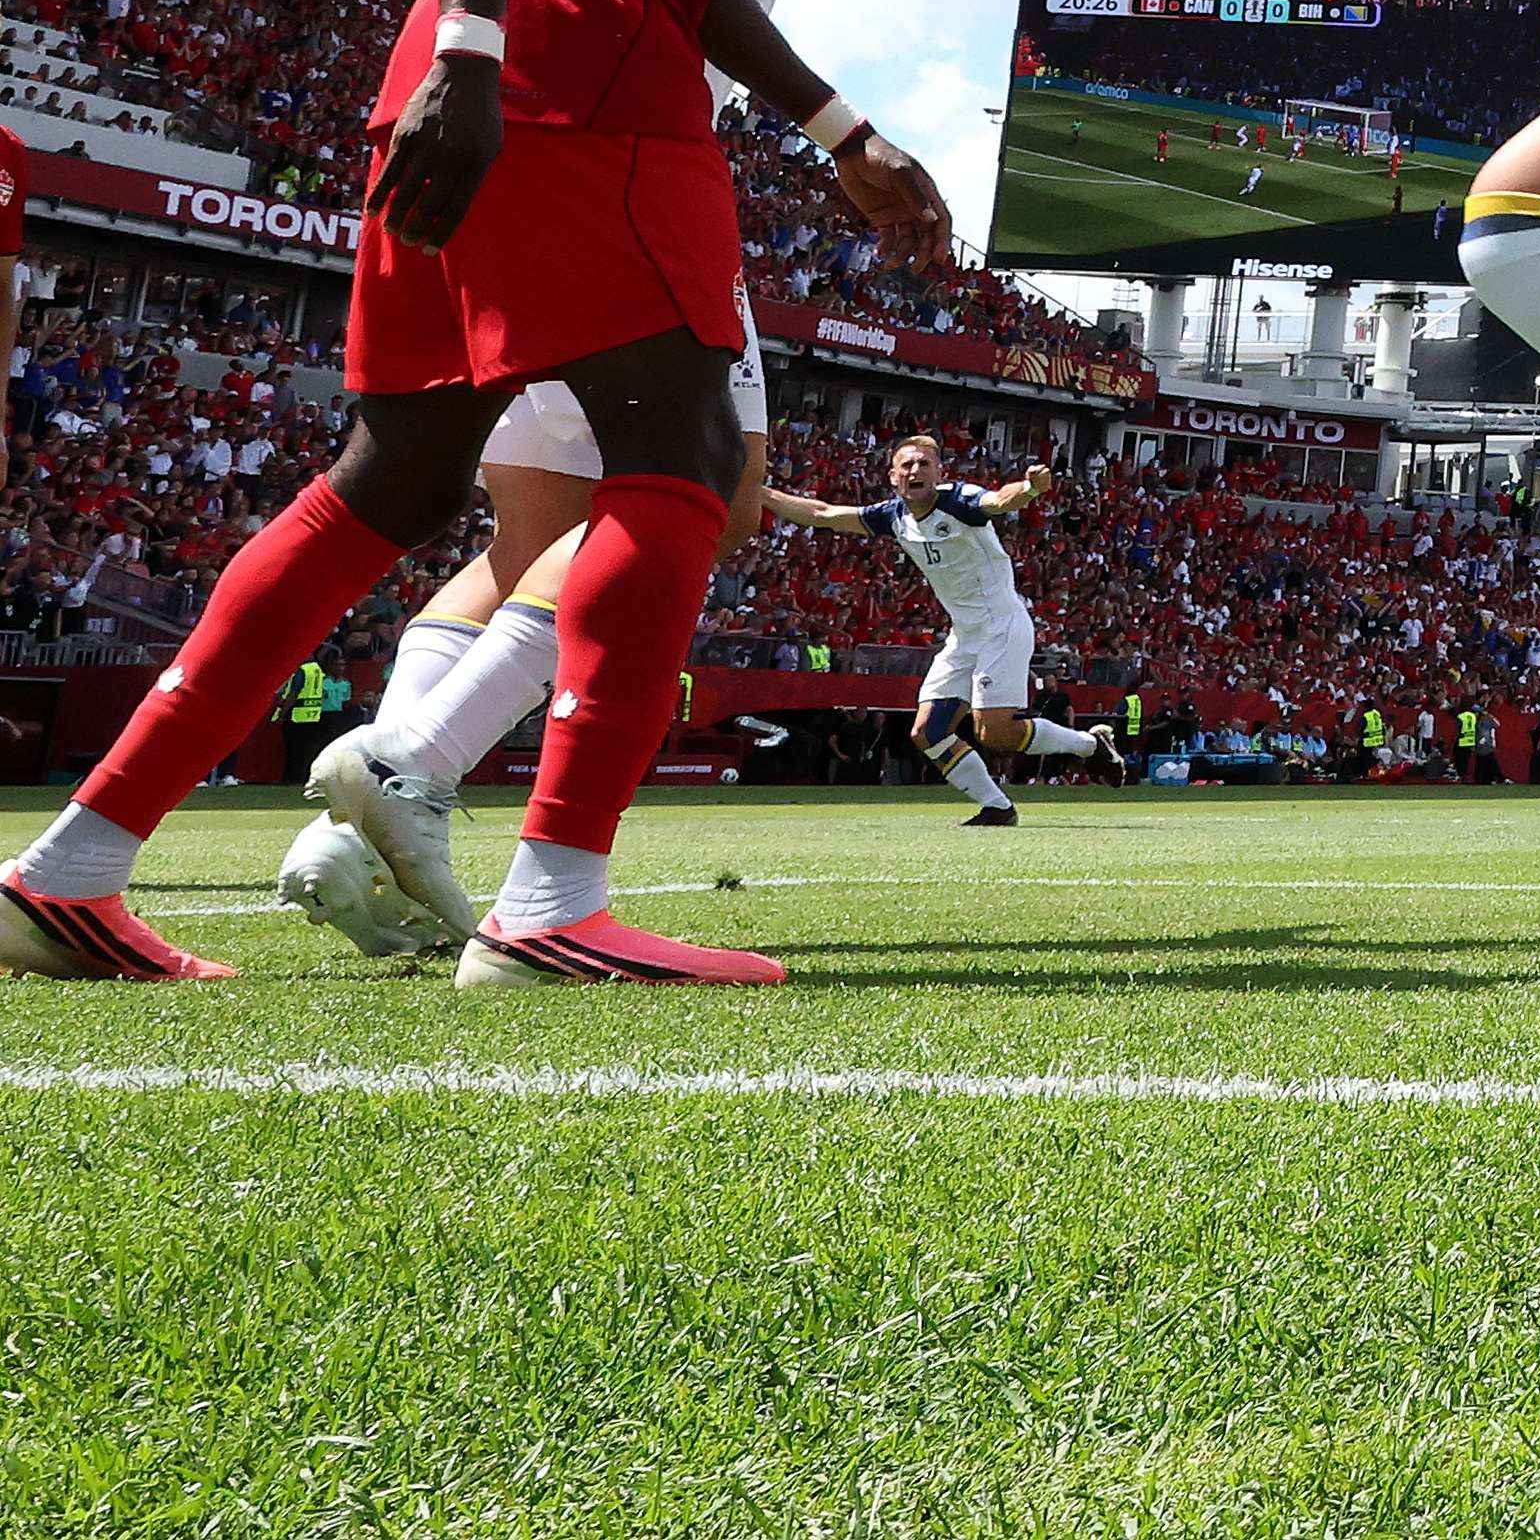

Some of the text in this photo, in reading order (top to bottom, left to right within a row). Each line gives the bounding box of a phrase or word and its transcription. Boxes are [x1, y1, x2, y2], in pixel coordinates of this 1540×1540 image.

[1226, 1, 1238, 16] 0
[1272, 3, 1284, 18] 0
[1299, 3, 1323, 19] BIH
[157, 180, 363, 250] TORONT
[1231, 258, 1334, 279] Hisense
[1167, 403, 1346, 444] TORONTO
[922, 541, 942, 565] 15
